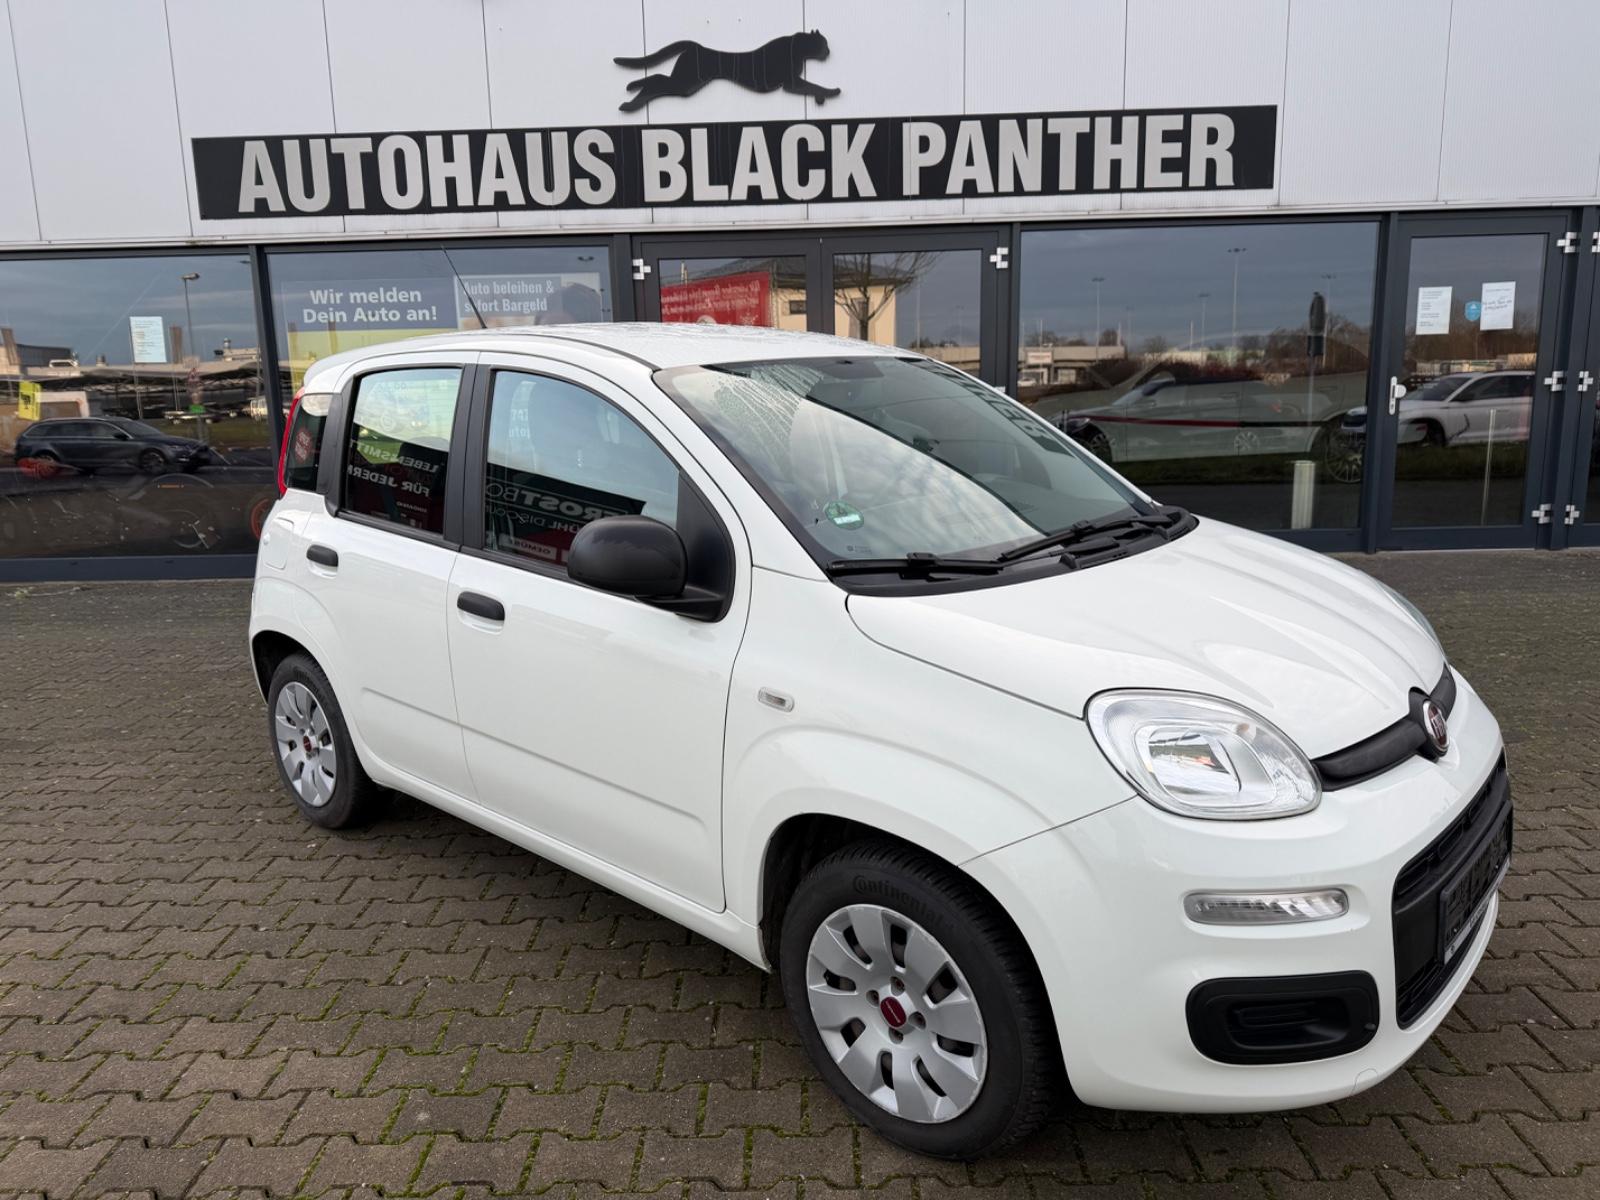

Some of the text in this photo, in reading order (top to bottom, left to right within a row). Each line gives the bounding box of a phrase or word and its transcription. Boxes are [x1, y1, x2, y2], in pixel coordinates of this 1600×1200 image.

[238, 113, 1236, 213] AUTOHAUS BLACK PANTHER
[309, 286, 422, 305] Wir melden
[463, 279, 555, 296] Auto beleihen &
[303, 305, 437, 323] Dein Auto an!
[502, 298, 548, 314] Bargeld
[853, 875, 945, 926] Continental
